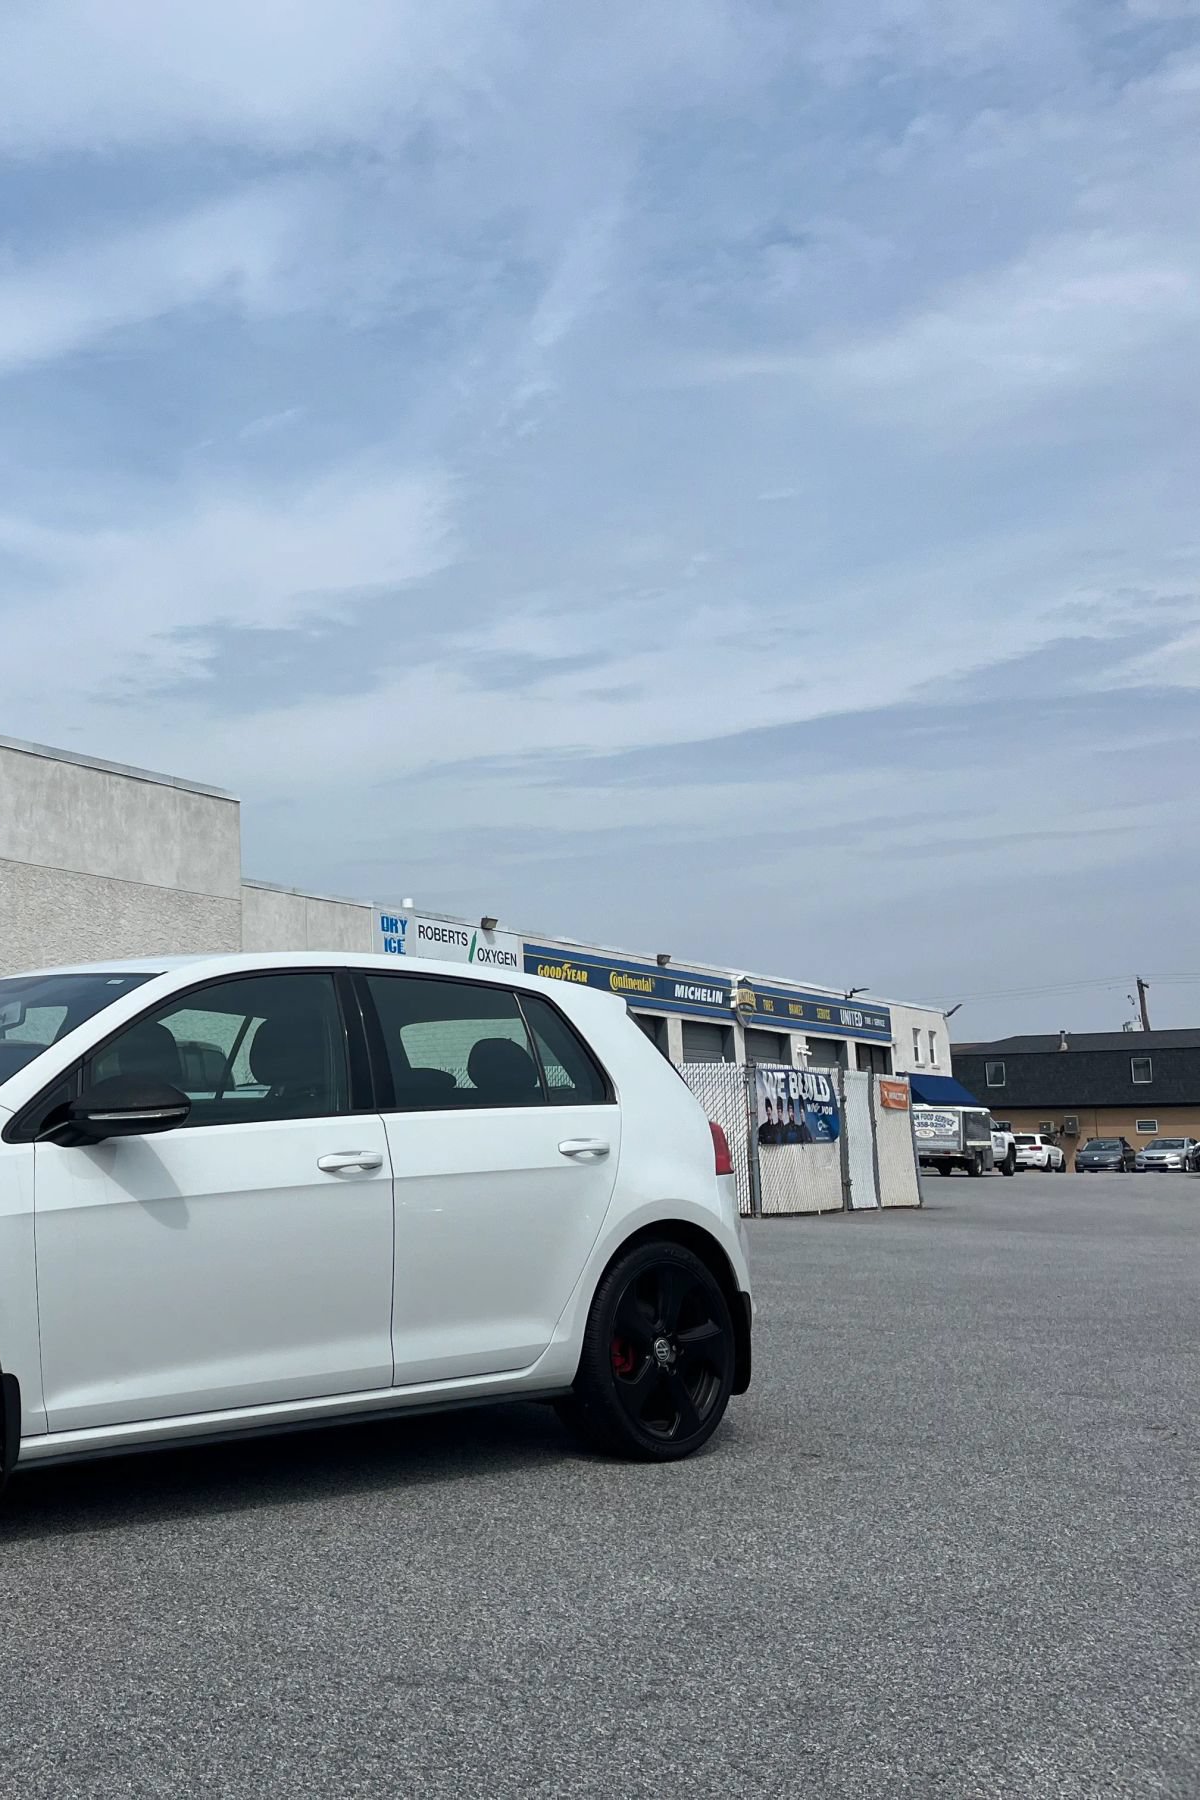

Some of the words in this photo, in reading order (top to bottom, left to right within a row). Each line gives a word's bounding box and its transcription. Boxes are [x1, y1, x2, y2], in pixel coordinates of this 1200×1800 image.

[381, 914, 408, 935] DRY
[417, 924, 469, 947] ROBERTS
[384, 937, 407, 956] ICE
[477, 947, 518, 968] OXYGEN
[537, 963, 588, 983] GOODYEAR
[609, 971, 652, 993] Continental
[674, 983, 724, 1004] MICHELIN
[839, 1008, 863, 1028] UNITED
[762, 1071, 787, 1100] WE
[788, 1071, 831, 1103] BUILD
